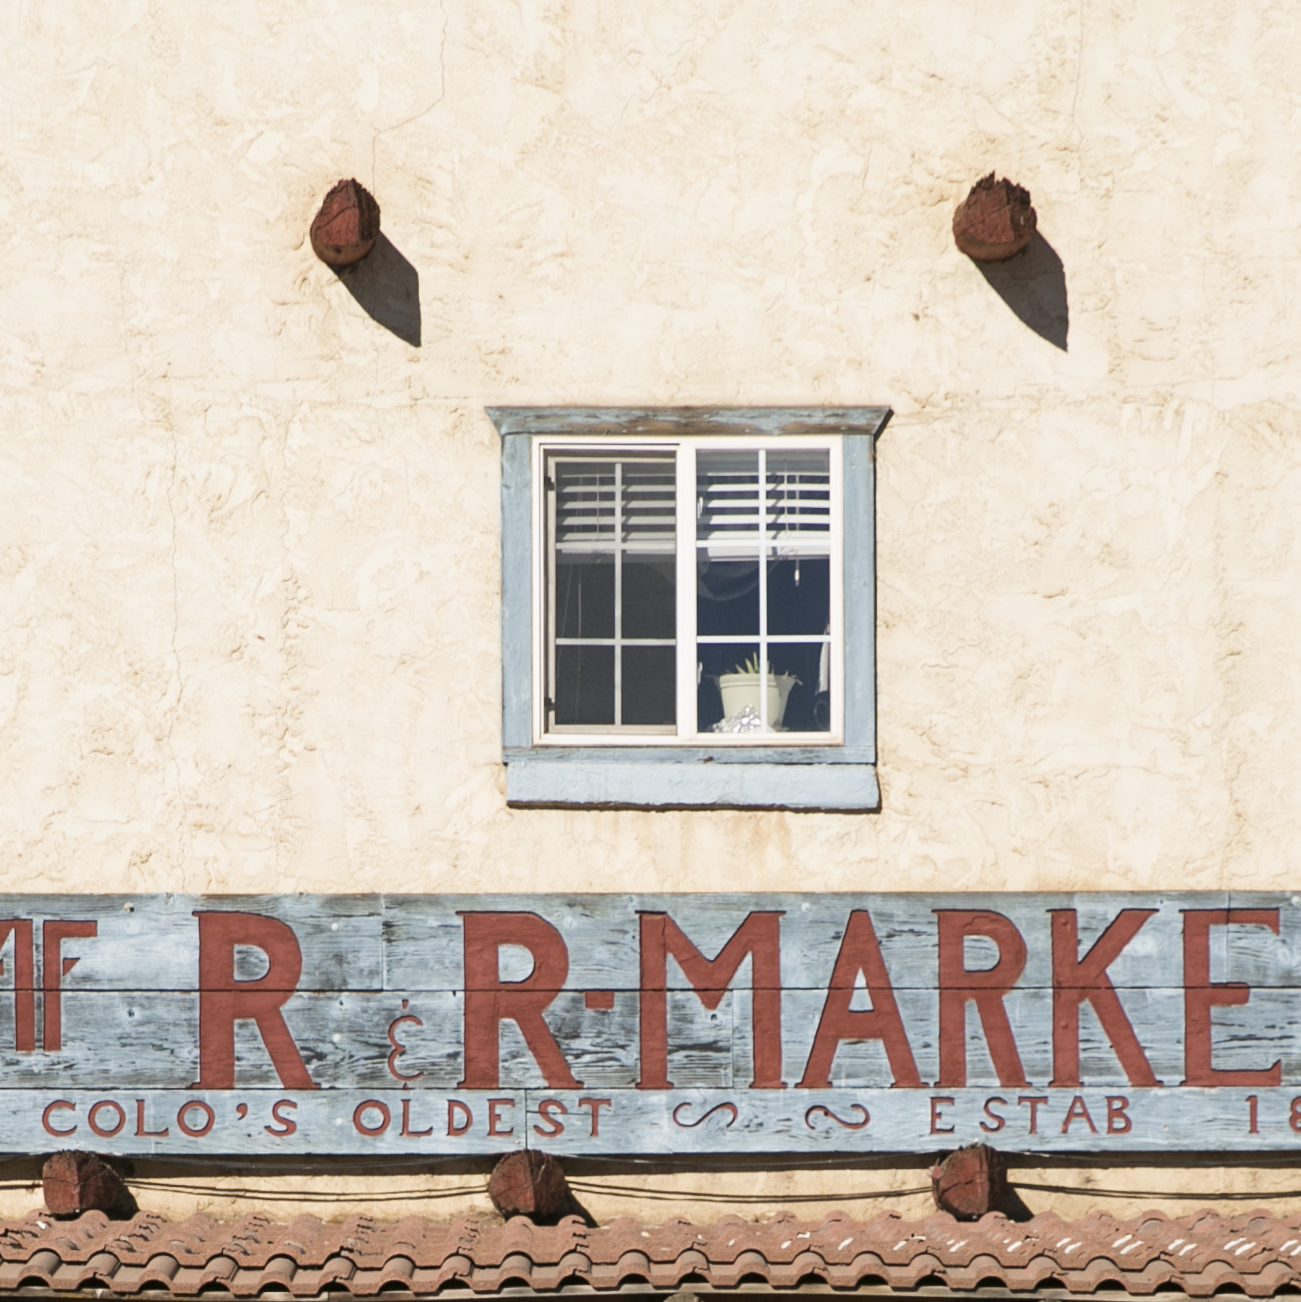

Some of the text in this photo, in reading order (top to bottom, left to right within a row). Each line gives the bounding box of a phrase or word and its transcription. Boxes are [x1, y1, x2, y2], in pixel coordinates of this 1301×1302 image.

[189, 910, 322, 1091] R
[387, 998, 426, 1090] &
[41, 1098, 299, 1138] COLO'S
[353, 1097, 613, 1138] OLDEST
[929, 1094, 1135, 1136] ESTAB
